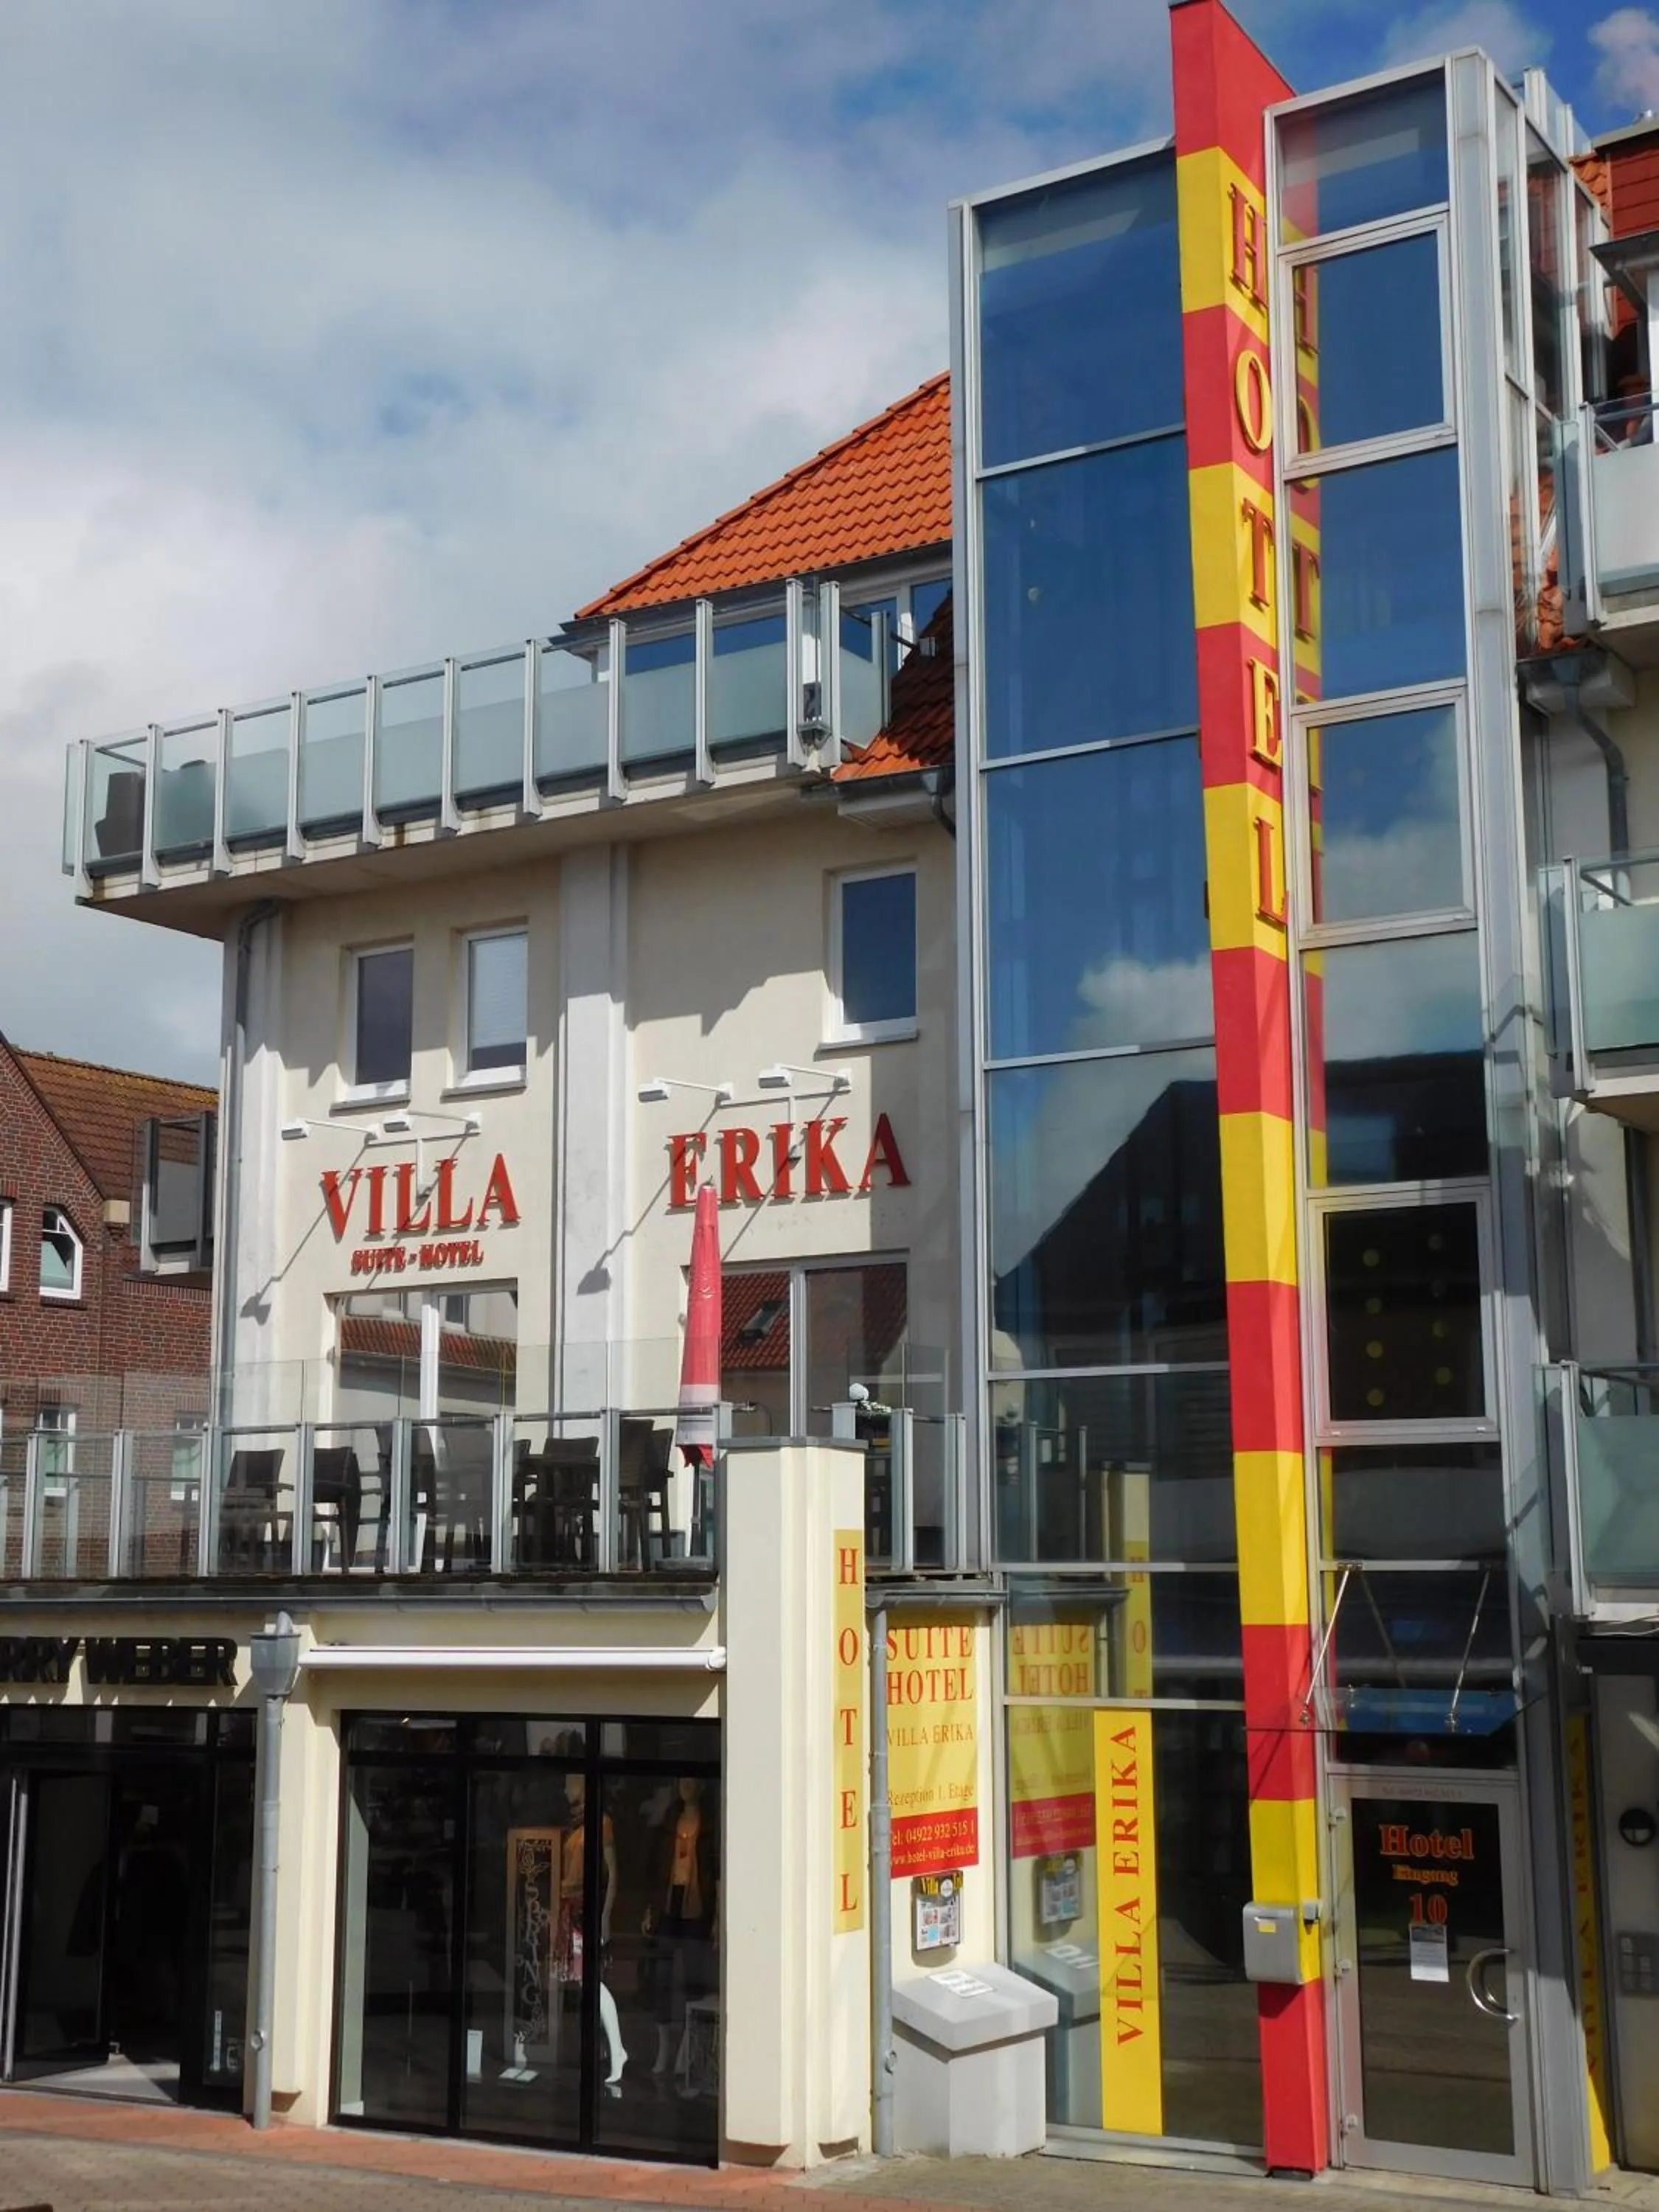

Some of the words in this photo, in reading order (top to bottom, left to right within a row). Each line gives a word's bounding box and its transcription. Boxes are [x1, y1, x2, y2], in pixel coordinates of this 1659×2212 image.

[1230, 182, 1289, 926] HOTEL
[320, 1152, 522, 1240] VILLA
[667, 1112, 912, 1208] ERIKA
[351, 1246, 406, 1274] SUITE
[419, 1239, 484, 1268] HOTEL
[85, 1636, 239, 1686] WEBER
[886, 1625, 973, 1661] SUITE
[886, 1669, 973, 1705] HOTEL
[838, 1548, 858, 1912] HOTEL
[933, 1723, 973, 1744] ERIKA
[1110, 1725, 1140, 1877] ERIKA
[1379, 1824, 1474, 1860] Hotel
[1409, 1893, 1447, 1926] 10
[1114, 1896, 1144, 2047] VILLA
